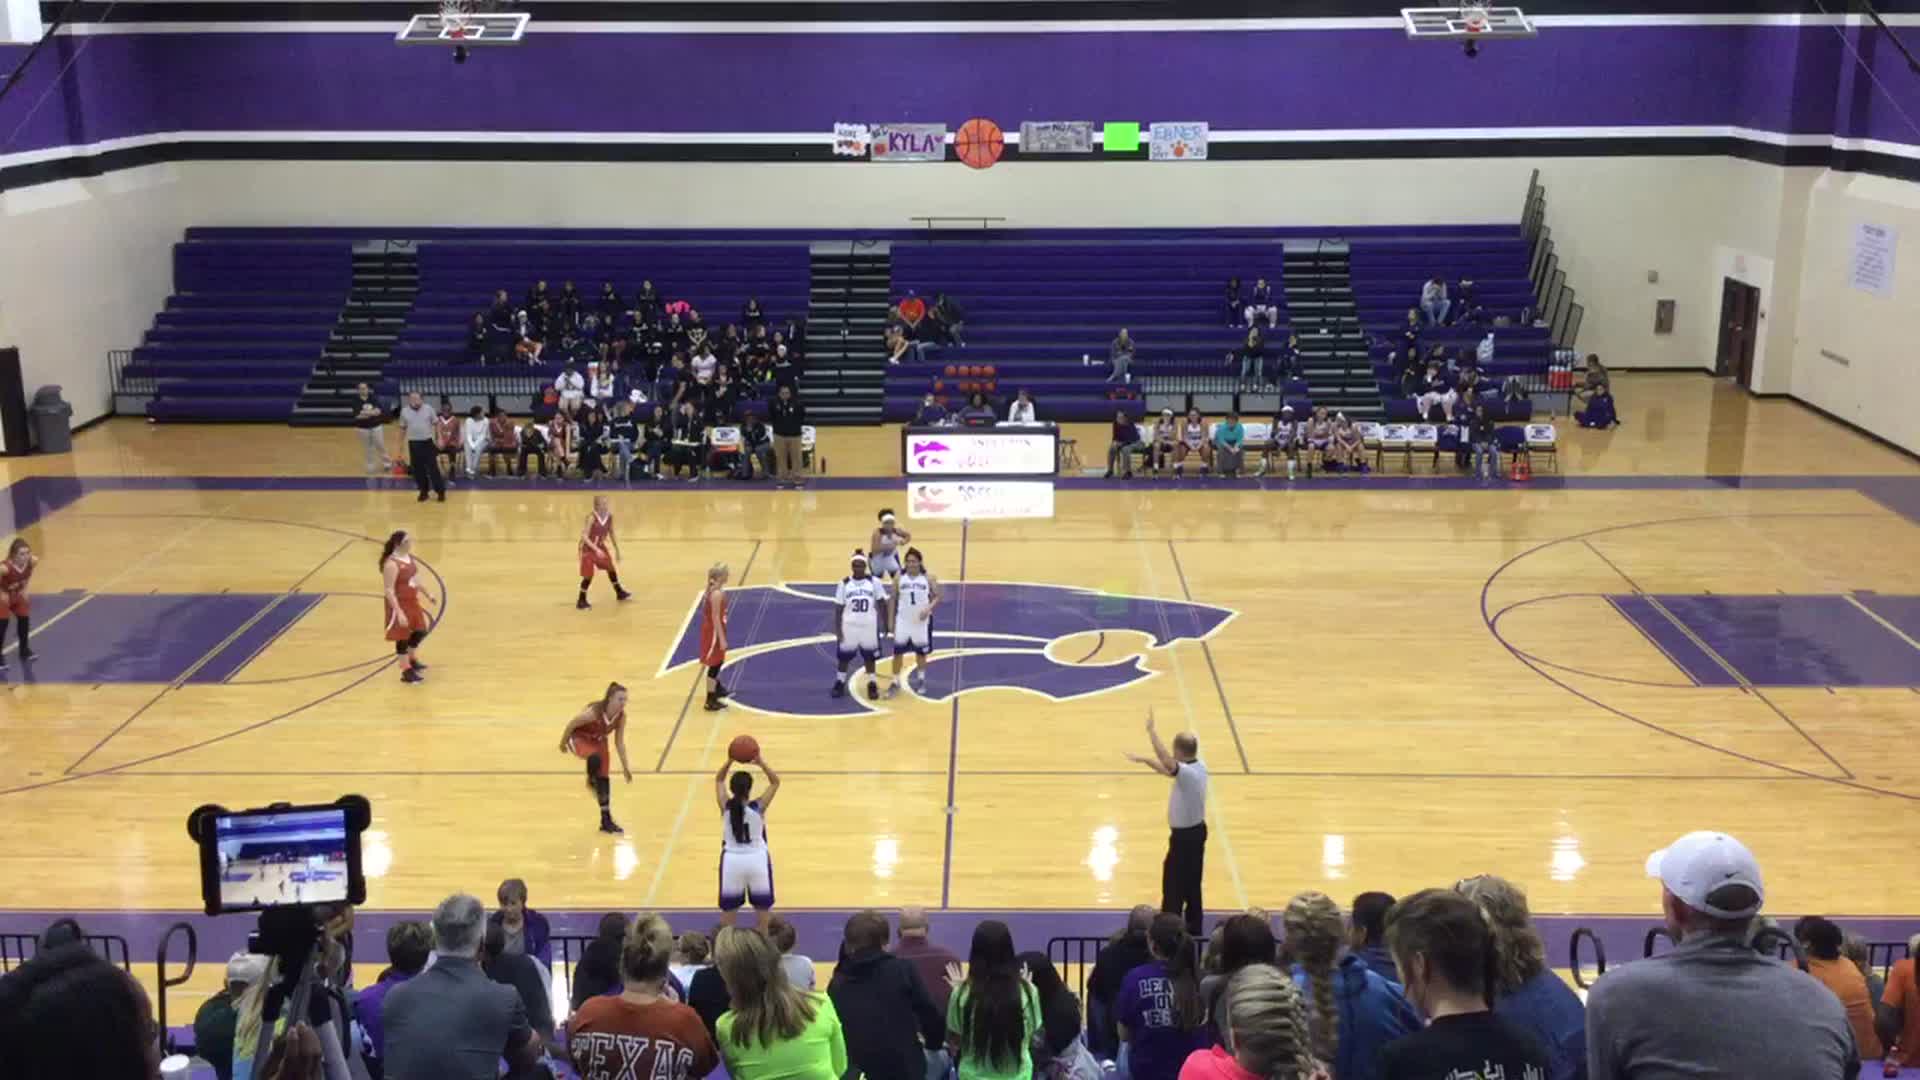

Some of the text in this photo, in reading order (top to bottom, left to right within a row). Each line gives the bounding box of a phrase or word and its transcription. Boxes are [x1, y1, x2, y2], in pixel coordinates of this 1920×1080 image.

[889, 132, 935, 152] KYLA
[851, 598, 870, 613] 30
[910, 591, 917, 605] 1
